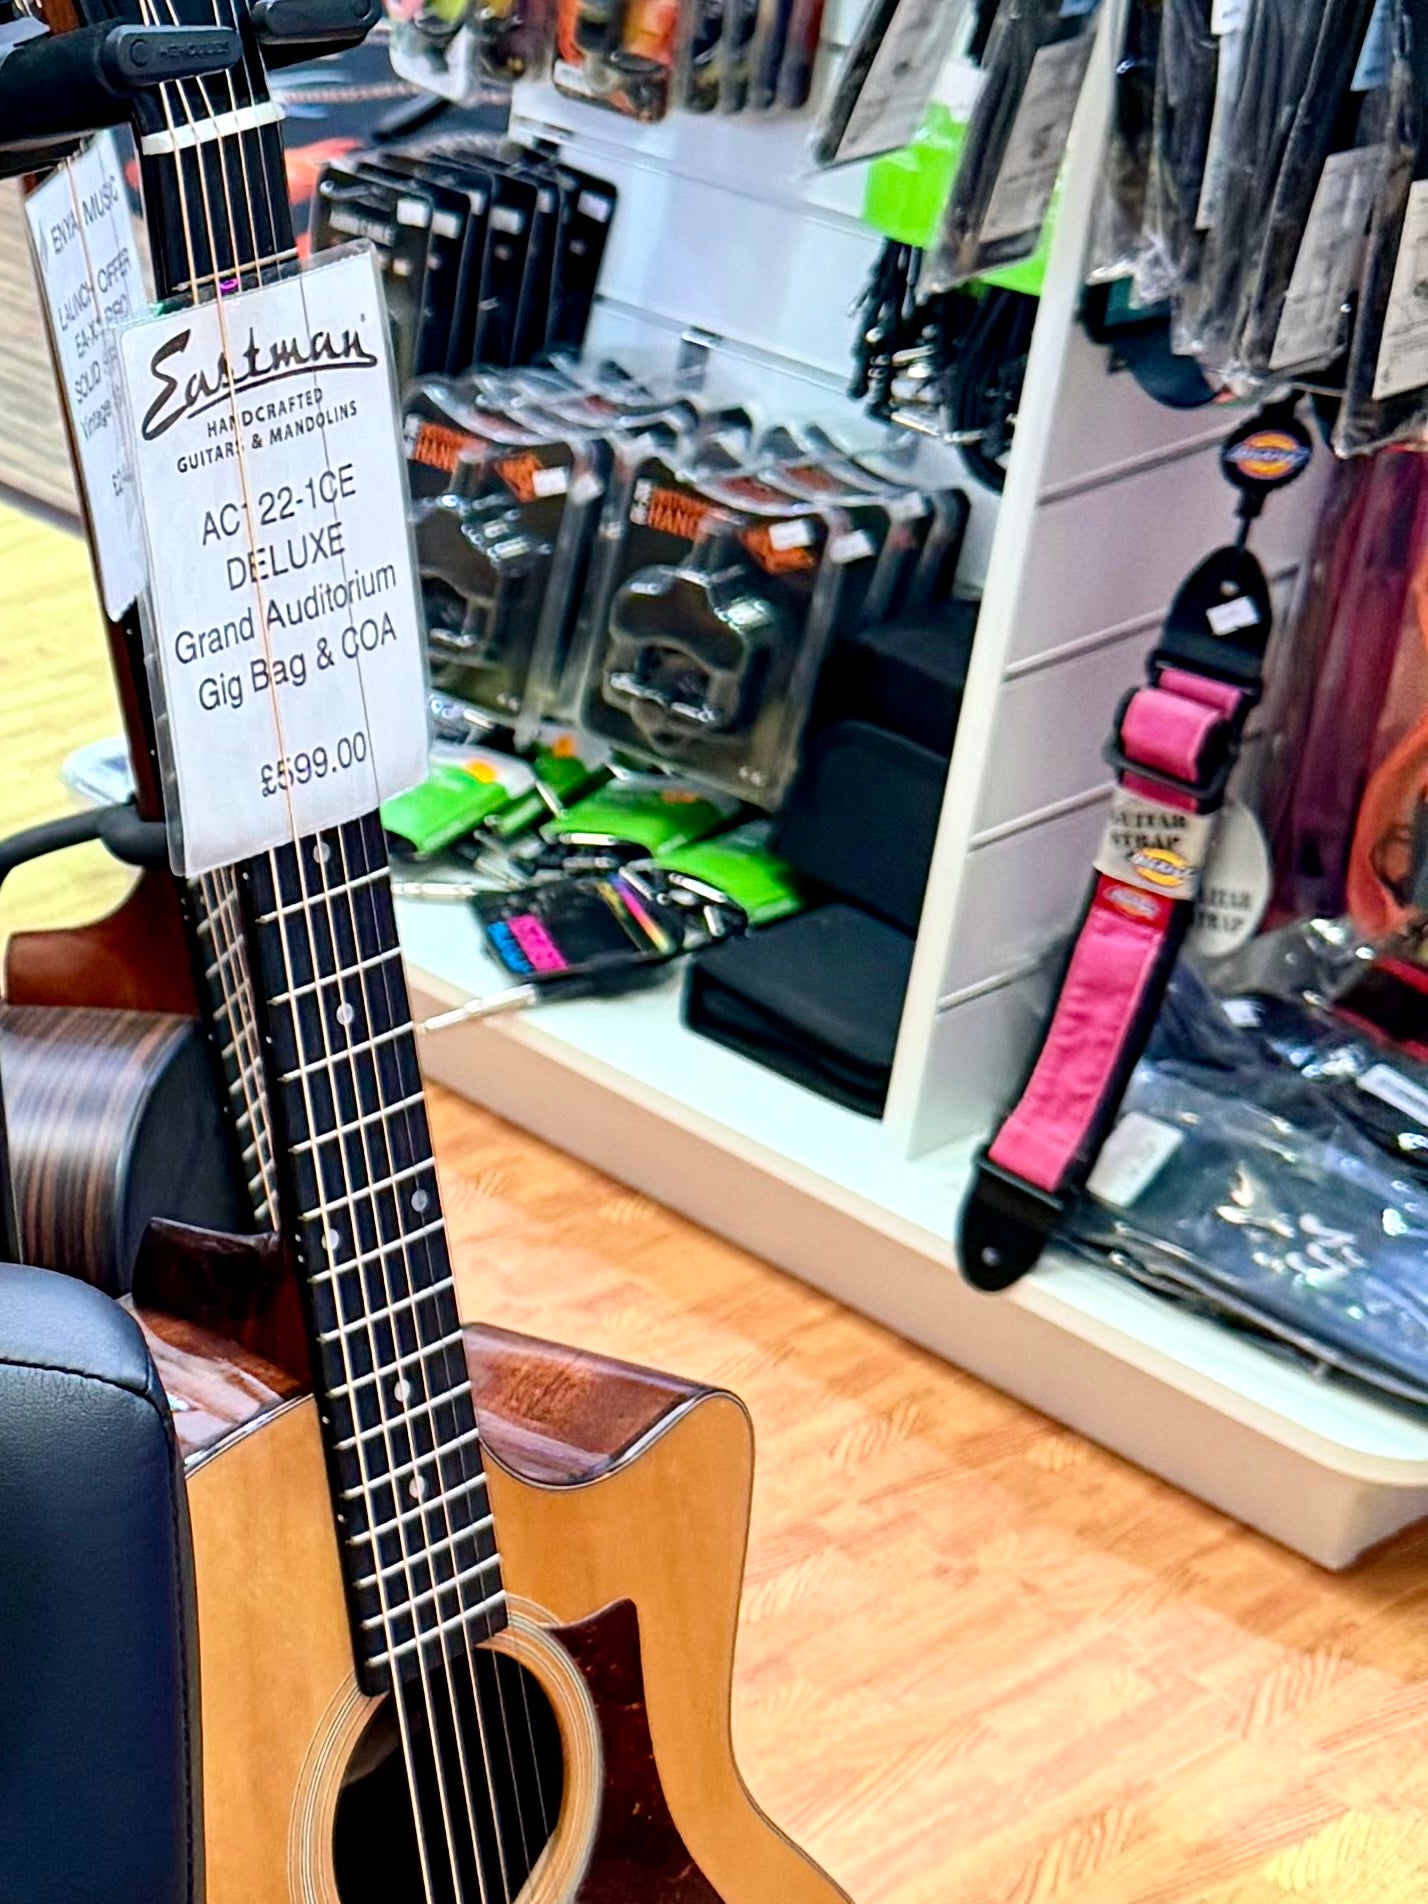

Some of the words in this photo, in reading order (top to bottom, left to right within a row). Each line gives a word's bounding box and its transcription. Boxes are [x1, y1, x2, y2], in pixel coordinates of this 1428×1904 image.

[50, 208, 80, 256] ENYA
[81, 175, 120, 231] MUSIC
[58, 280, 95, 333] LAUNCH
[96, 246, 132, 295] OFFER
[141, 326, 379, 441] Eastman
[207, 387, 324, 439] HANDCRAFTED
[251, 433, 264, 450] &
[269, 399, 358, 446] MANDOLINS
[201, 463, 357, 547] AC22-1CE
[226, 521, 346, 592] DELUXE
[174, 607, 256, 665] Grand
[265, 563, 397, 633] Auditorium
[198, 672, 244, 711] Gig
[250, 652, 307, 693] Bag
[316, 636, 335, 670] &
[341, 611, 398, 660] COA
[259, 730, 368, 798] £599.00
[1114, 811, 1187, 829] UITAR
